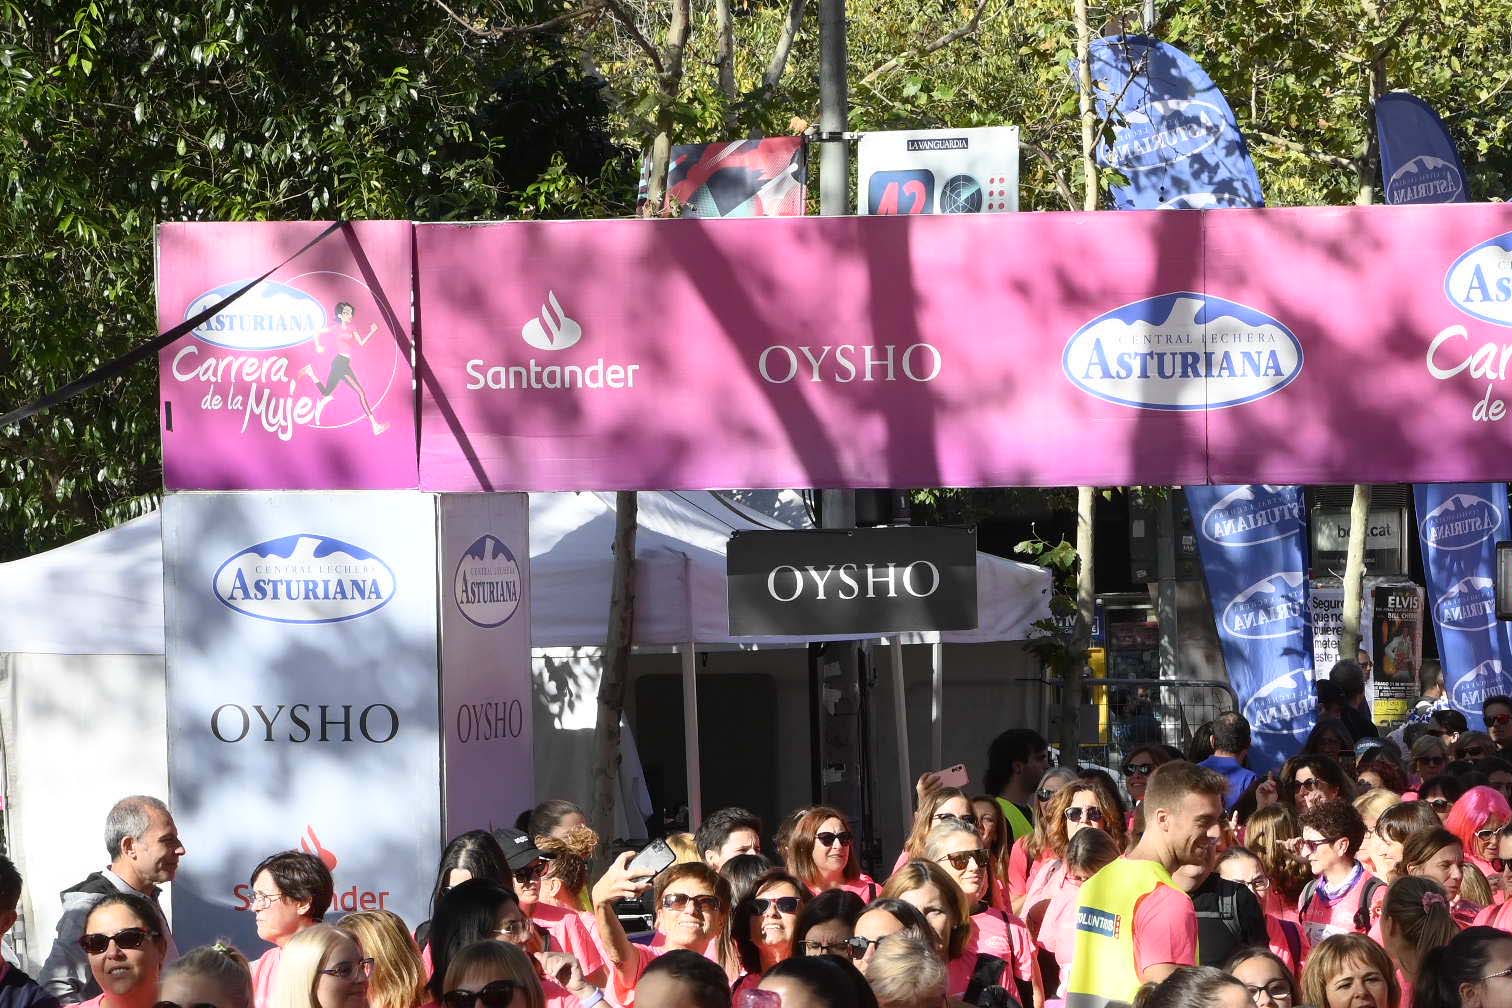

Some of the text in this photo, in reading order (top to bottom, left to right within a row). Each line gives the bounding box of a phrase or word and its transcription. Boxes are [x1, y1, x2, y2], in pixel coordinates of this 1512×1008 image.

[919, 140, 968, 149] VANGUARDIA
[171, 346, 291, 384] Carrera
[465, 360, 640, 390] Santander
[759, 343, 941, 383] OYSHO
[1083, 338, 1284, 380] ASTURIANA
[200, 381, 331, 441] de la Mujer
[1472, 385, 1507, 421] de
[227, 568, 383, 602] ASTURIANA
[460, 570, 517, 604] ASTURIANA
[767, 560, 940, 602] OYSHO
[1313, 611, 1329, 625] que
[1387, 596, 1418, 608] ELVIS
[211, 703, 400, 743] OYSHO
[456, 699, 522, 743] OYSHO
